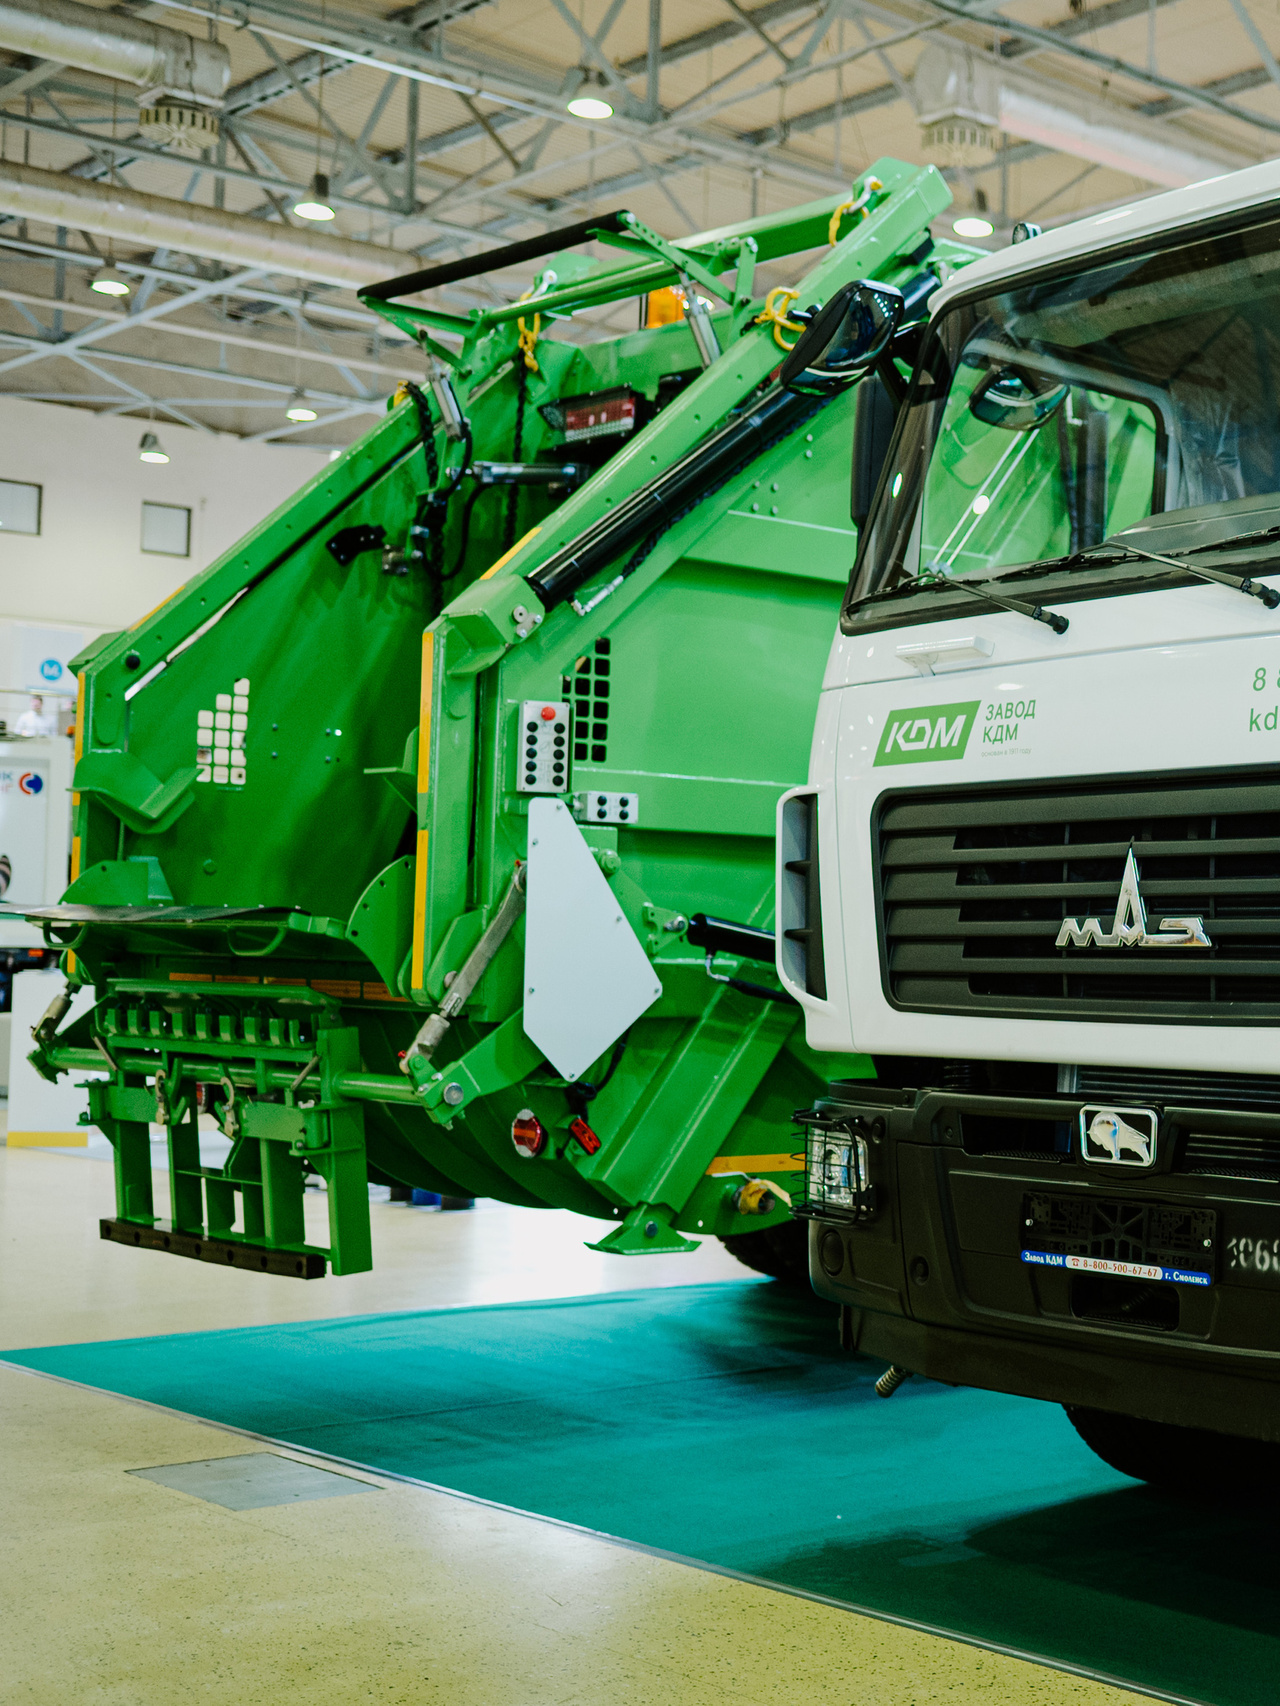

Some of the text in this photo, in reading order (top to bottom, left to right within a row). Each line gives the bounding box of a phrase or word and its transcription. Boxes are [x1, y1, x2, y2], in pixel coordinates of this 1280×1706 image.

[1252, 667, 1267, 691] 8
[985, 699, 1037, 721] ЗАВОД
[982, 723, 1019, 745] КДМ
[1045, 1254, 1063, 1266] КДМ
[1083, 1260, 1158, 1278] 8-800-500-67-67
